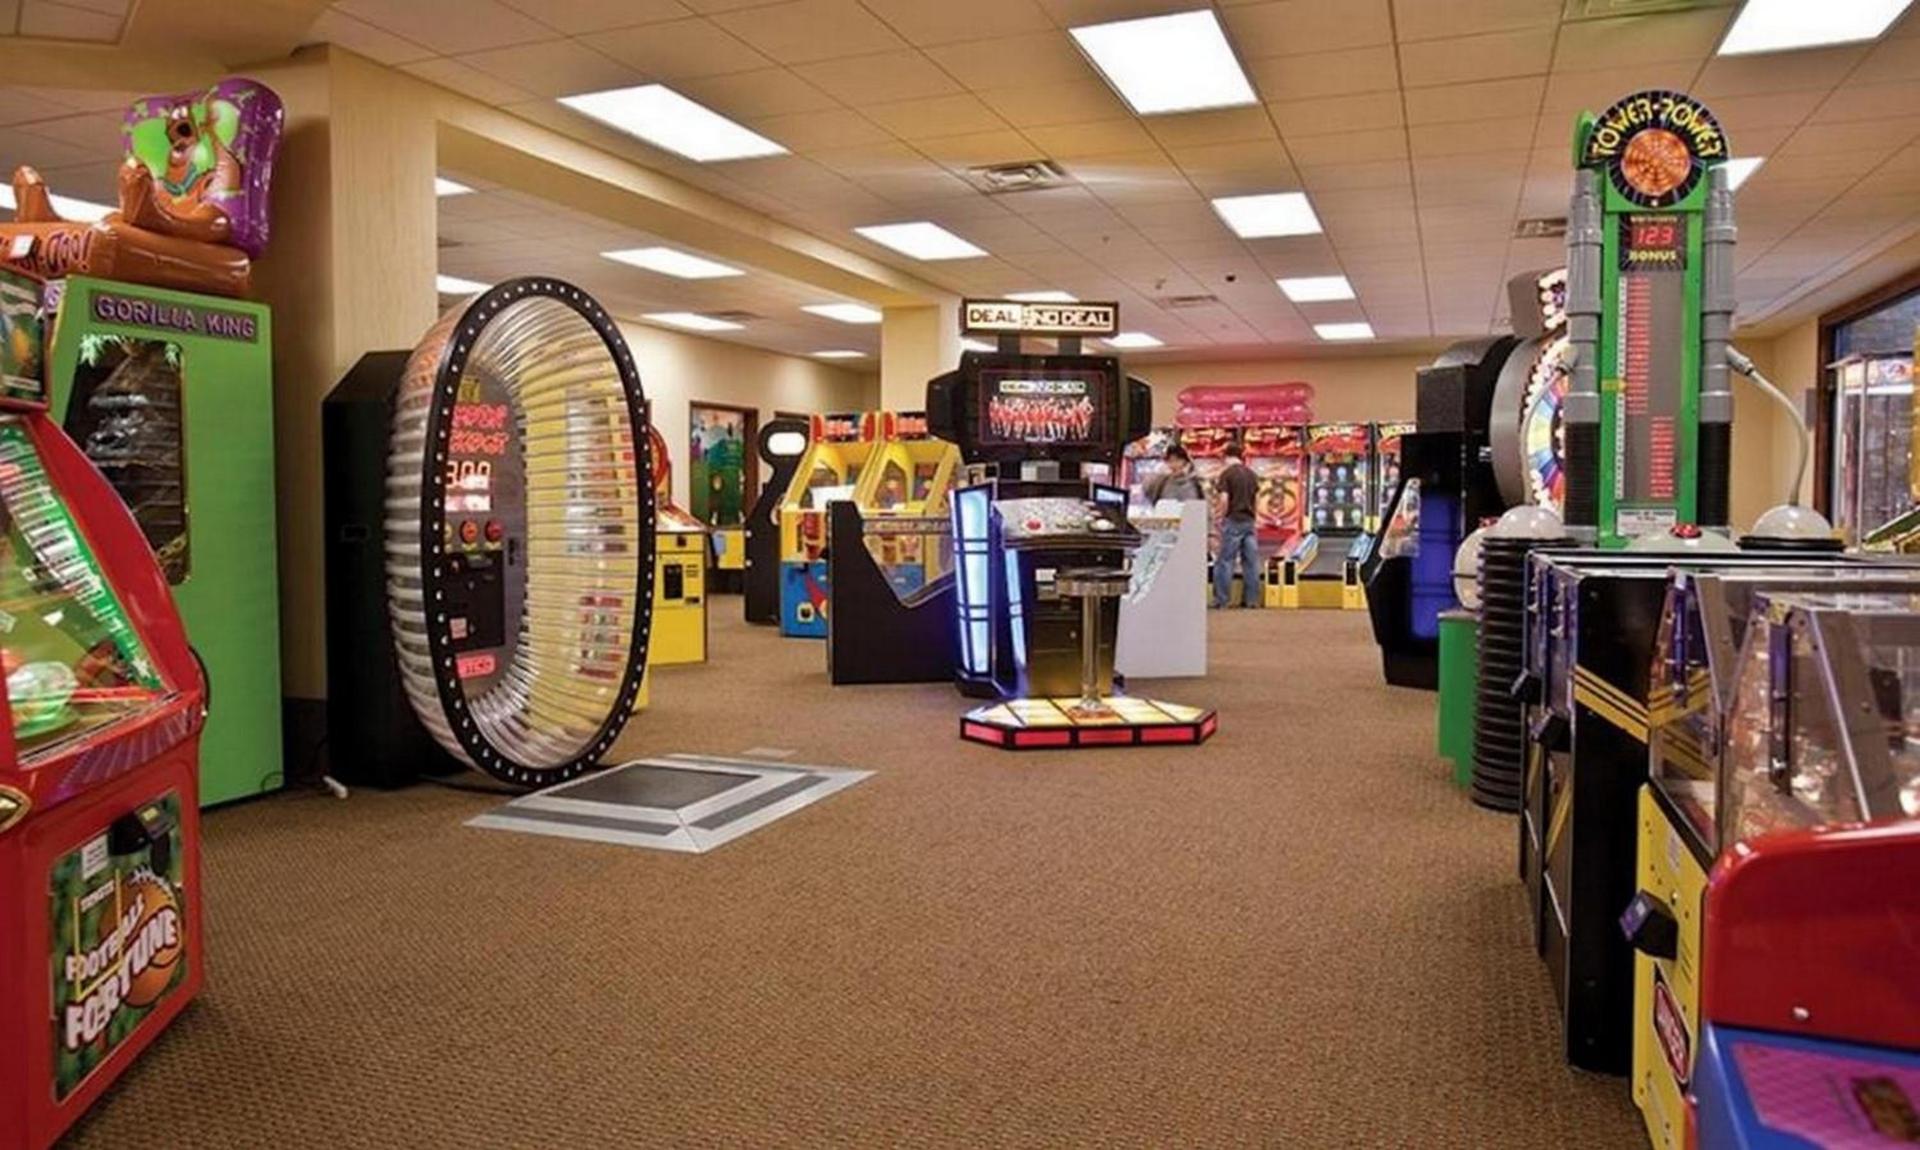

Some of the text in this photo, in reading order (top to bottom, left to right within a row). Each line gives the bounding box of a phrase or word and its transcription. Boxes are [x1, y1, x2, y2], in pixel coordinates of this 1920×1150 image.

[1591, 98, 1722, 157] TOWER POWER
[1637, 226, 1674, 245] 123
[1629, 249, 1676, 262] BONUS
[97, 295, 255, 338] GORILLA KING
[969, 308, 1017, 324] DEAL
[1033, 309, 1060, 326] NO
[1061, 310, 1112, 327] DEAL
[65, 906, 178, 1049] FORTUNE
